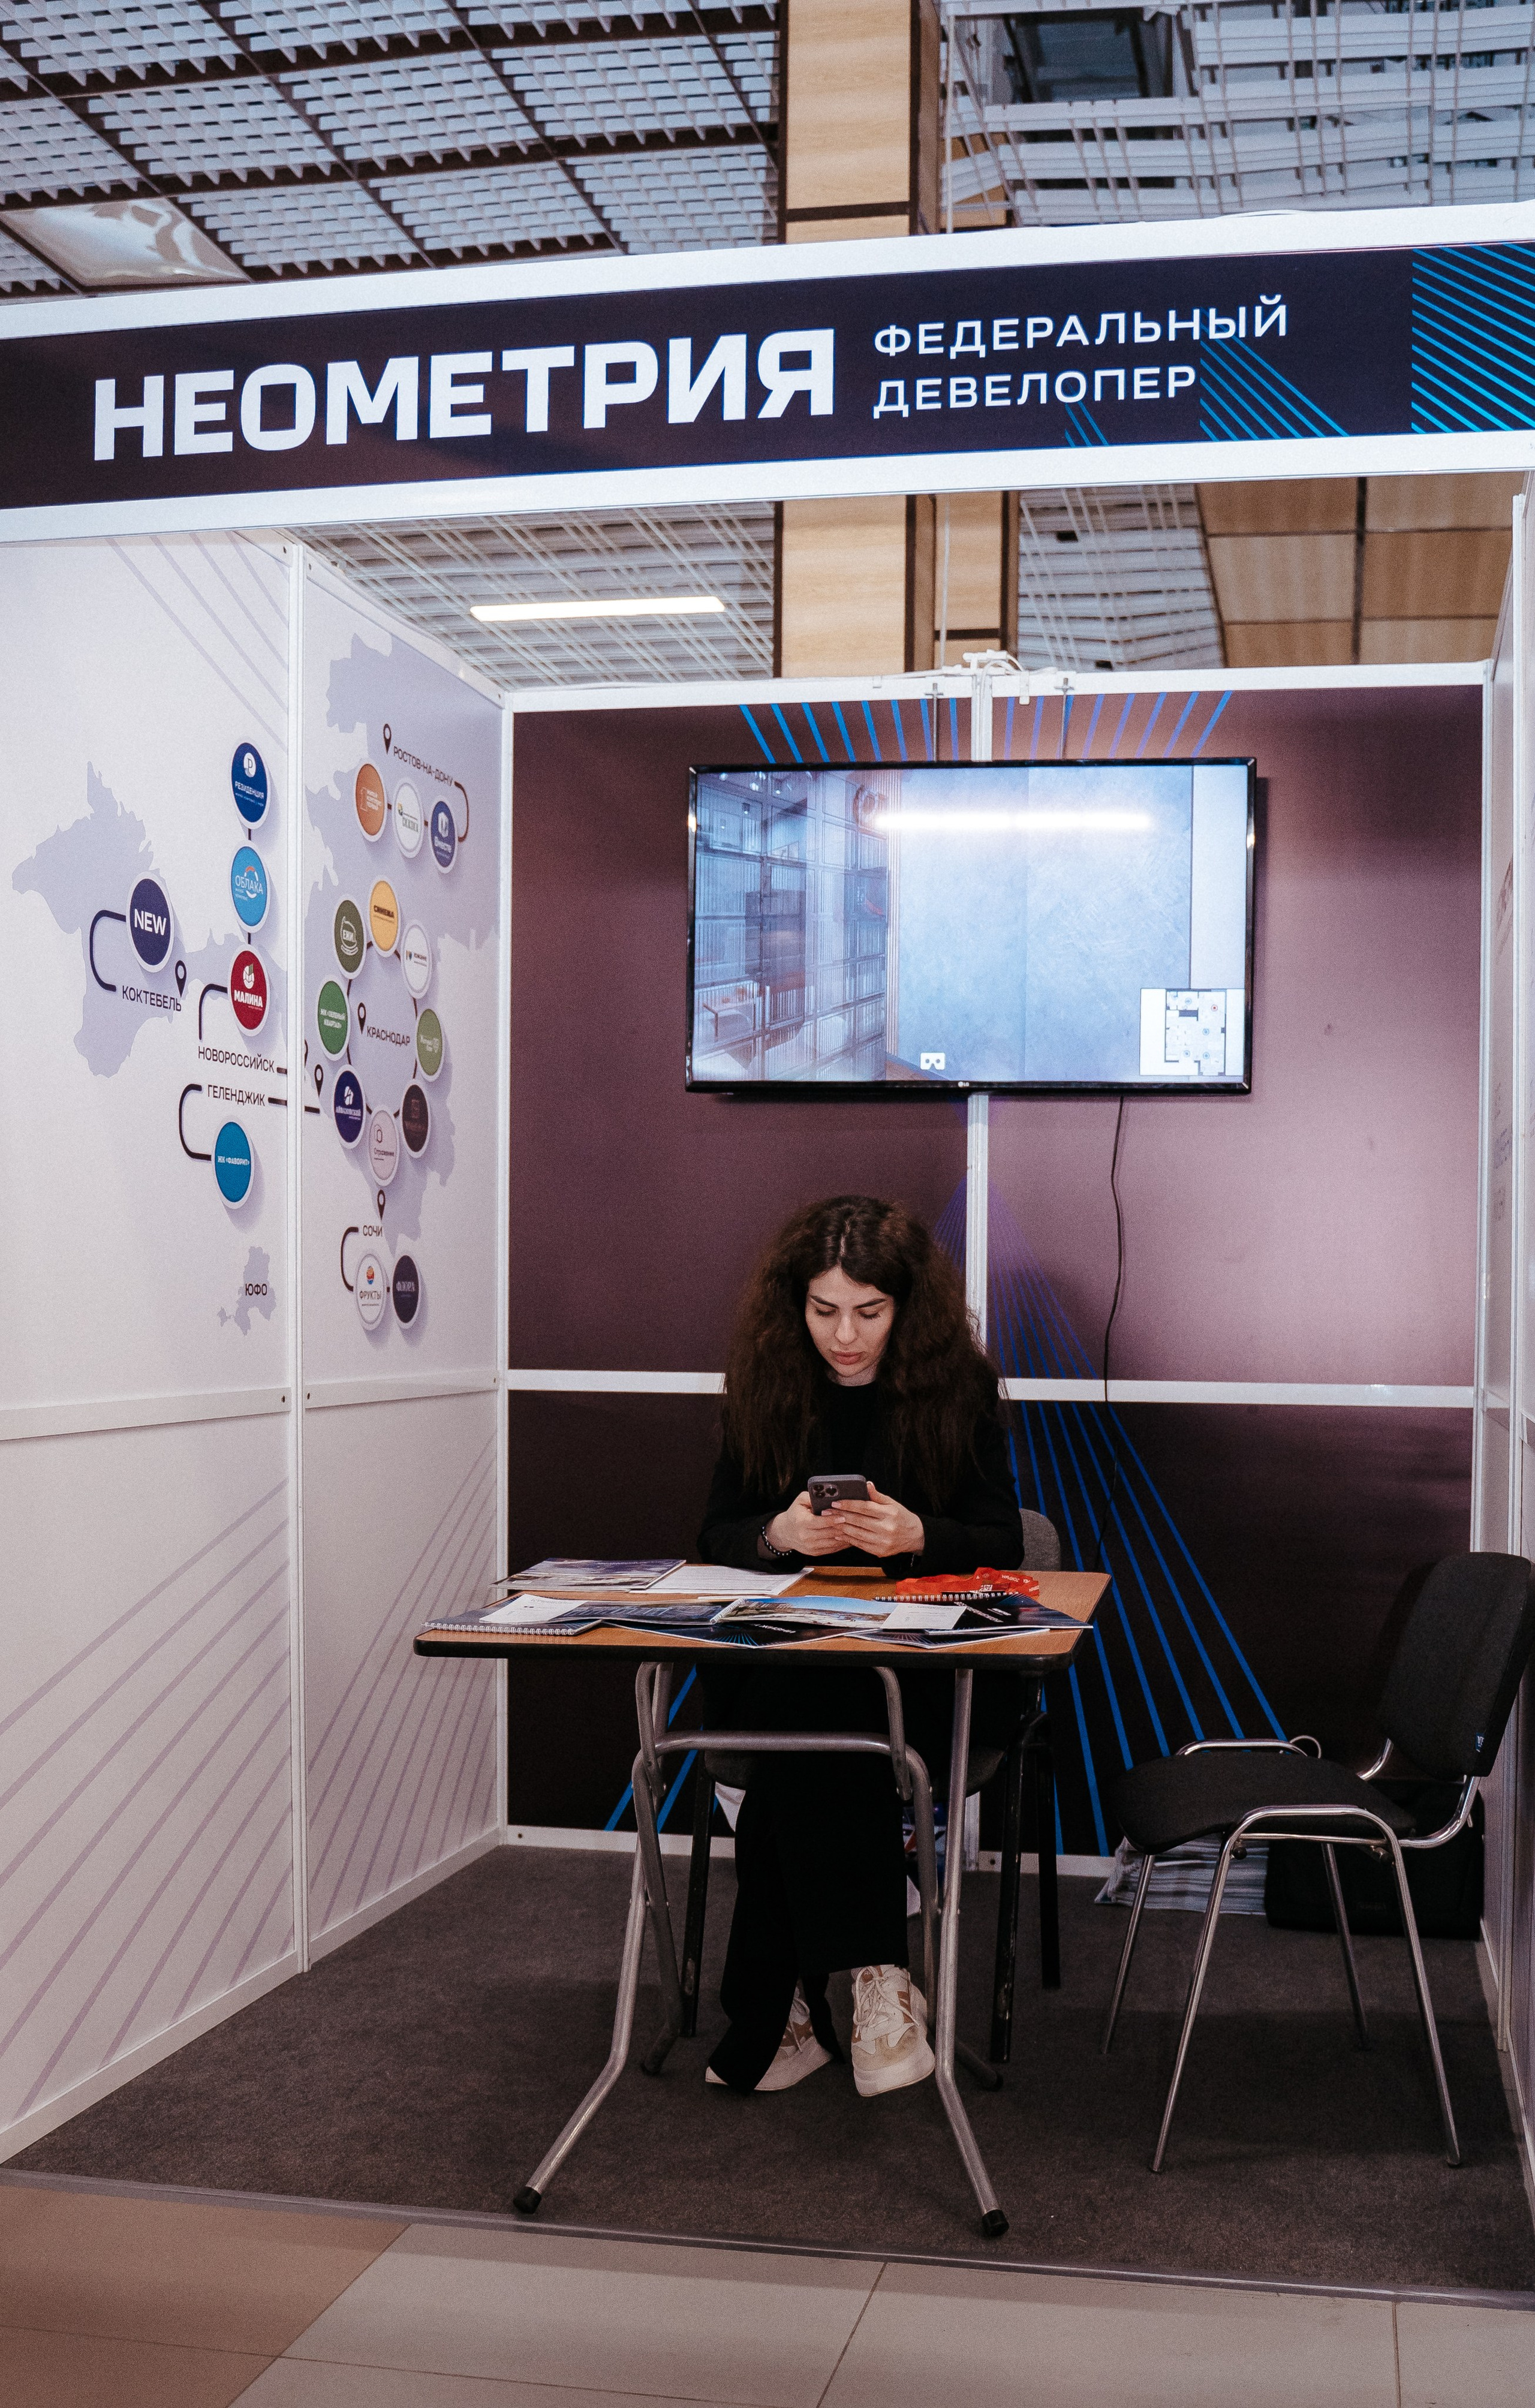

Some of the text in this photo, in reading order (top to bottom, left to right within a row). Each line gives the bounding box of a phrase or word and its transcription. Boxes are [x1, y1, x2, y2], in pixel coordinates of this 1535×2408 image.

[873, 294, 1287, 360] ФЕДЕРАЛЬНЫЙ
[94, 328, 835, 461] НЕОМЕТРИЯ
[873, 366, 1196, 419] ДЕВЕЛОПЕР
[393, 745, 454, 787] РОСТОВ-НА-ДОНУ
[234, 875, 264, 895] ОБЛАКА
[133, 908, 167, 936] NEW
[122, 985, 182, 1013] КОКТЕБЕЛЬ
[234, 989, 263, 1007] МАЛИНА
[366, 1025, 410, 1048] КРАСНОДАР
[197, 1045, 275, 1073] НОВОРОССИЙСК
[207, 1084, 266, 1107] ГЕЛЕНДЖИК
[363, 1224, 383, 1237] СОЧИ
[245, 1283, 268, 1296] ЮФО
[359, 1290, 381, 1300] ФРУКТЫ
